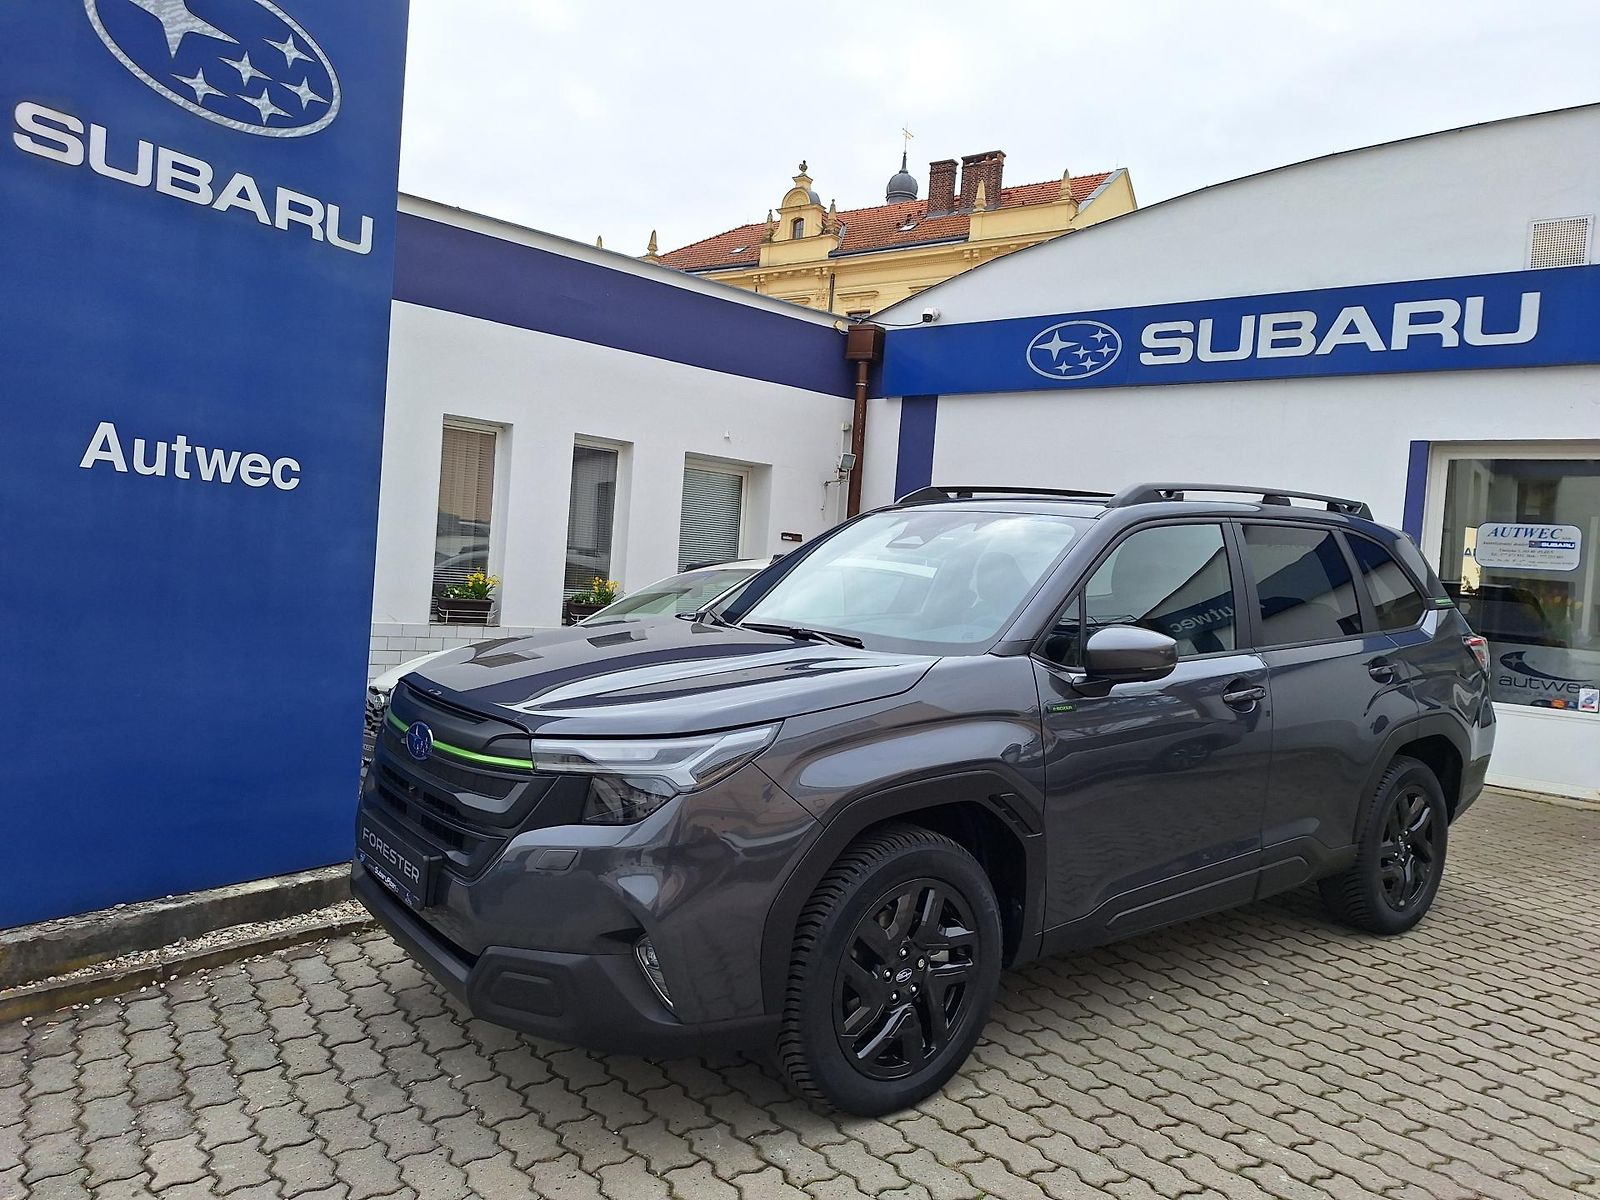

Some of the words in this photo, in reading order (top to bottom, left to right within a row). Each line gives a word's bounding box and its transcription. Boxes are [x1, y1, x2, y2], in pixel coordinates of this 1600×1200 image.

[13, 101, 374, 255] SUBARU
[1139, 291, 1541, 365] SUBARU
[79, 421, 301, 490] Autwec
[1487, 526, 1564, 540] AUTWEC
[362, 827, 420, 884] FORESTER
